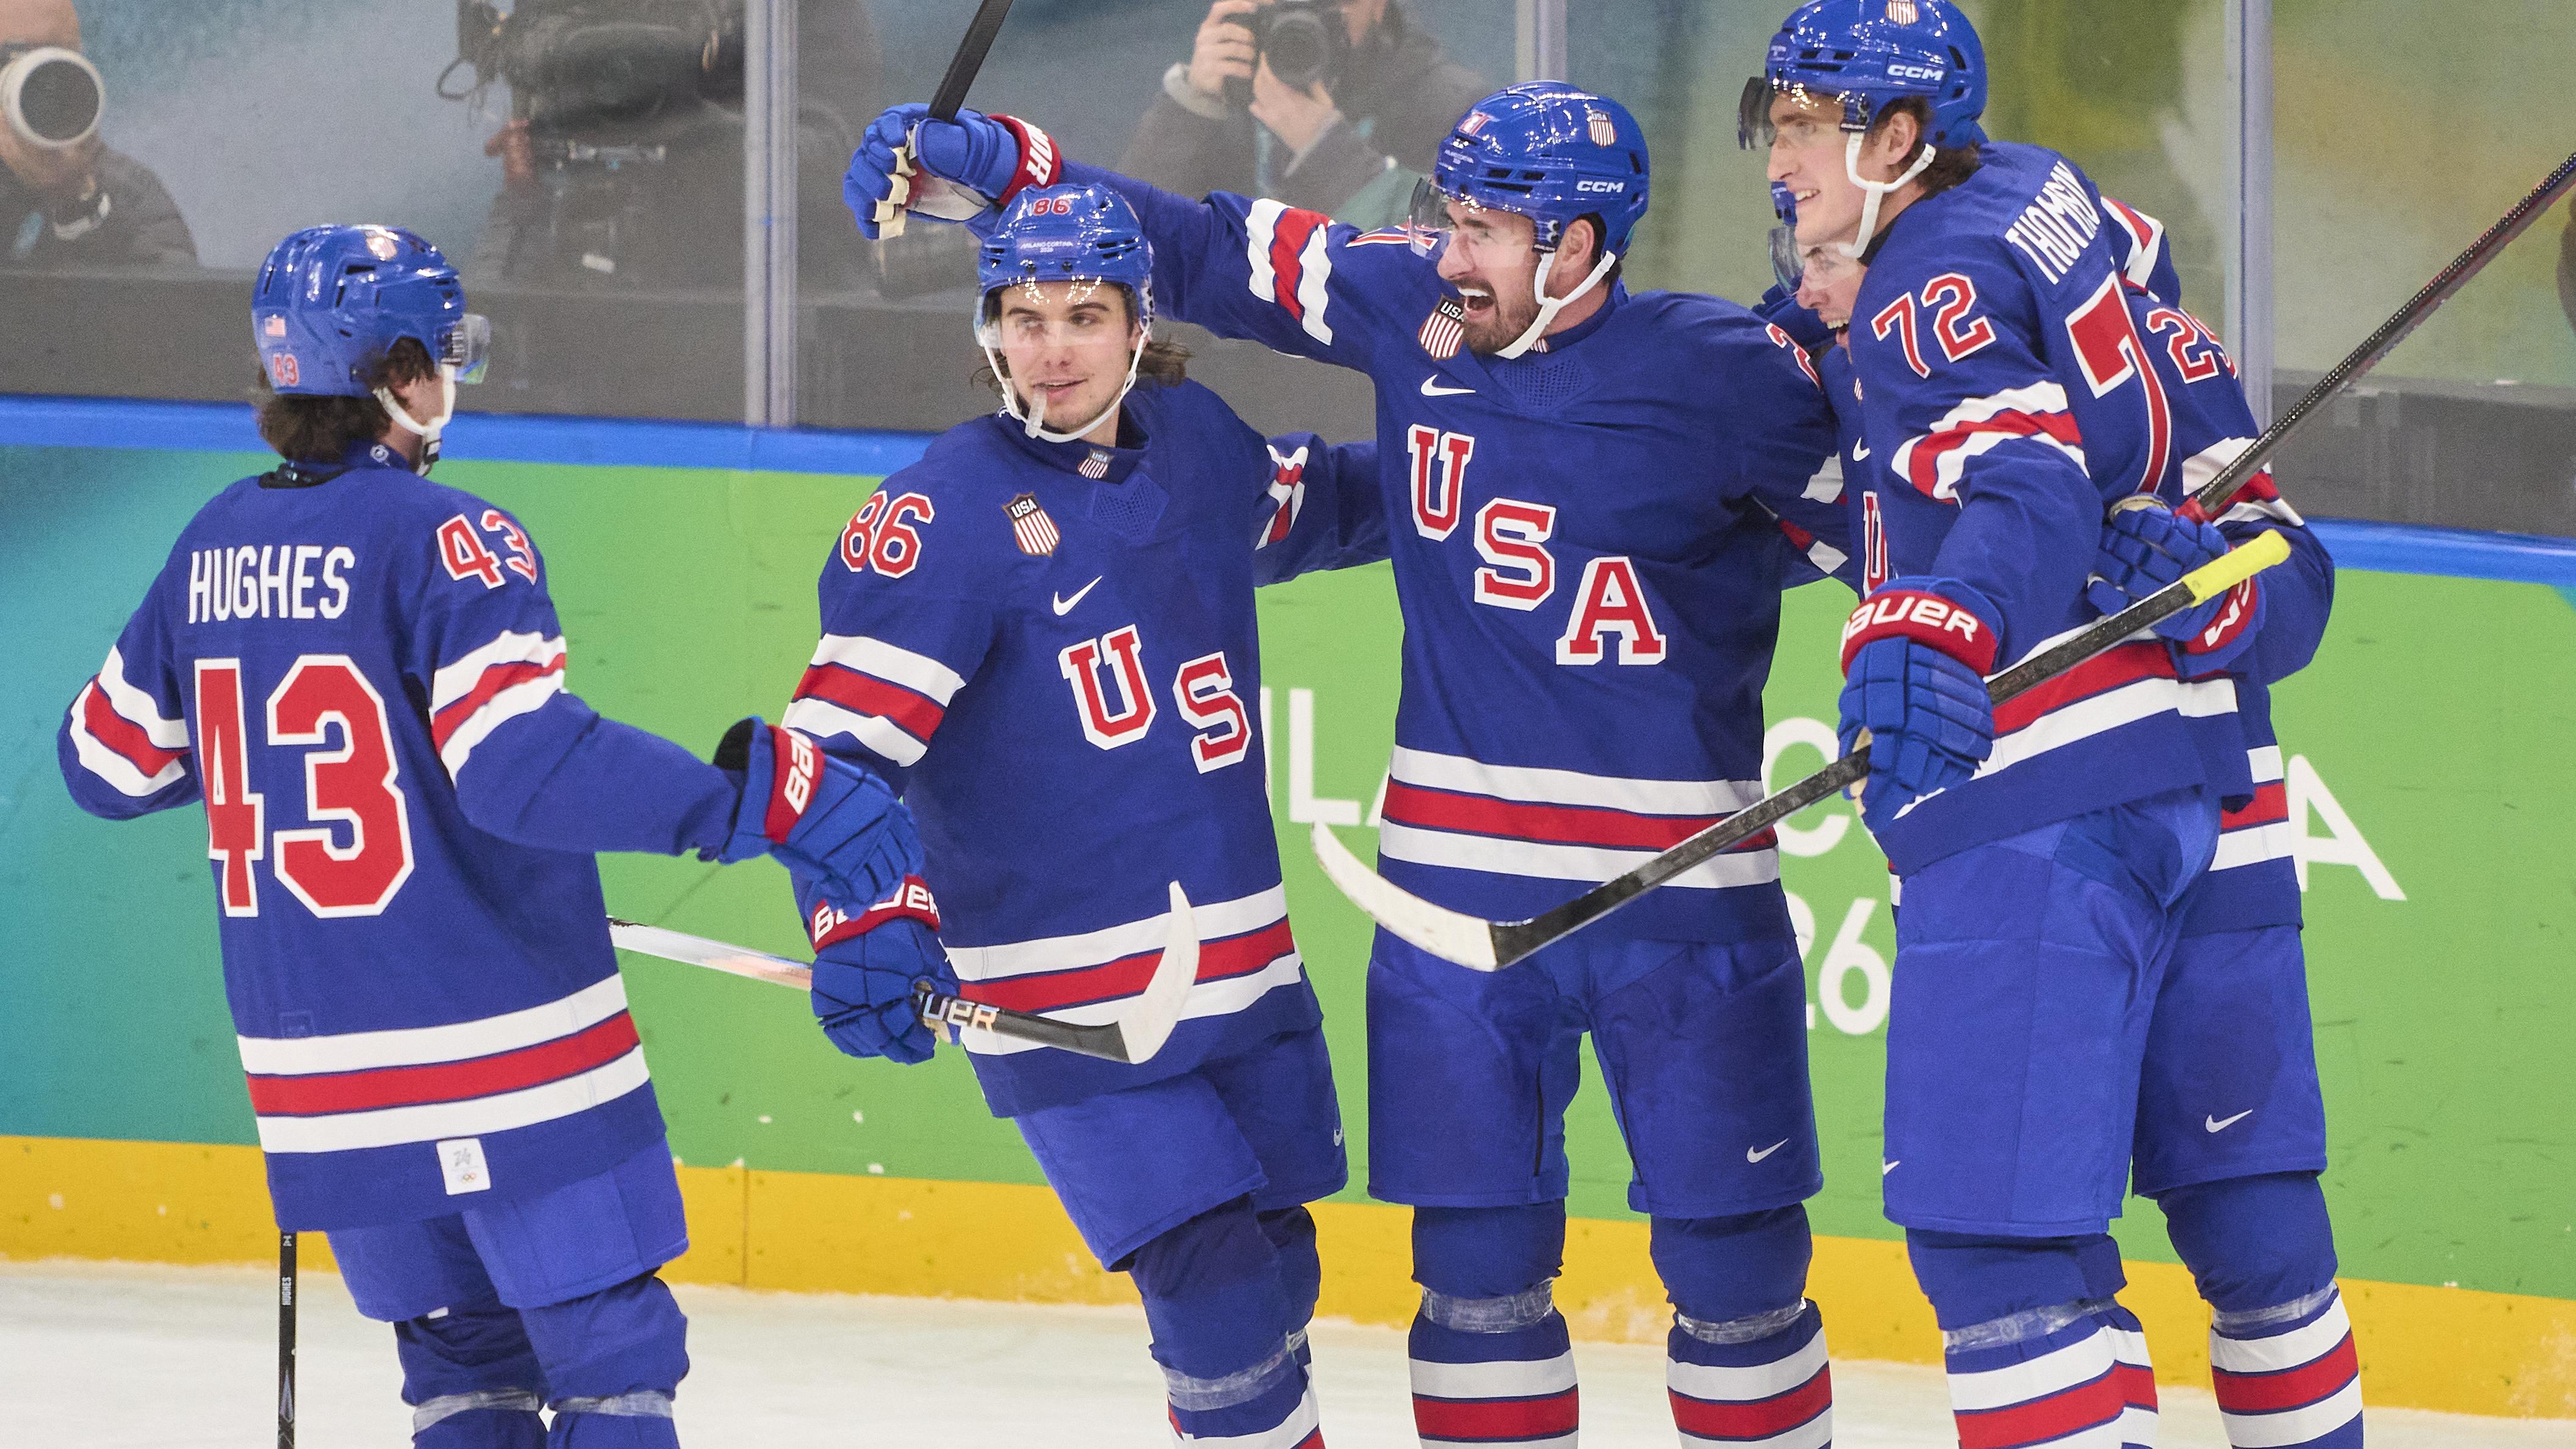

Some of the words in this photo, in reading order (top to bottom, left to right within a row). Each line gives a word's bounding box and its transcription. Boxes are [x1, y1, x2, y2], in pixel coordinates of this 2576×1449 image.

[1887, 65, 1944, 81] CCM
[1032, 197, 1073, 216] 86
[1577, 181, 1624, 193] CCM
[1871, 272, 1996, 379] 72
[273, 353, 299, 386] 43
[2065, 271, 2171, 493] 7
[841, 490, 935, 578] 86
[1011, 498, 1037, 518] USA
[436, 510, 538, 589] 43
[189, 545, 355, 623] HUGHES
[1839, 596, 1978, 653] AUER
[194, 654, 415, 918] 43
[917, 992, 1000, 1031] UER
